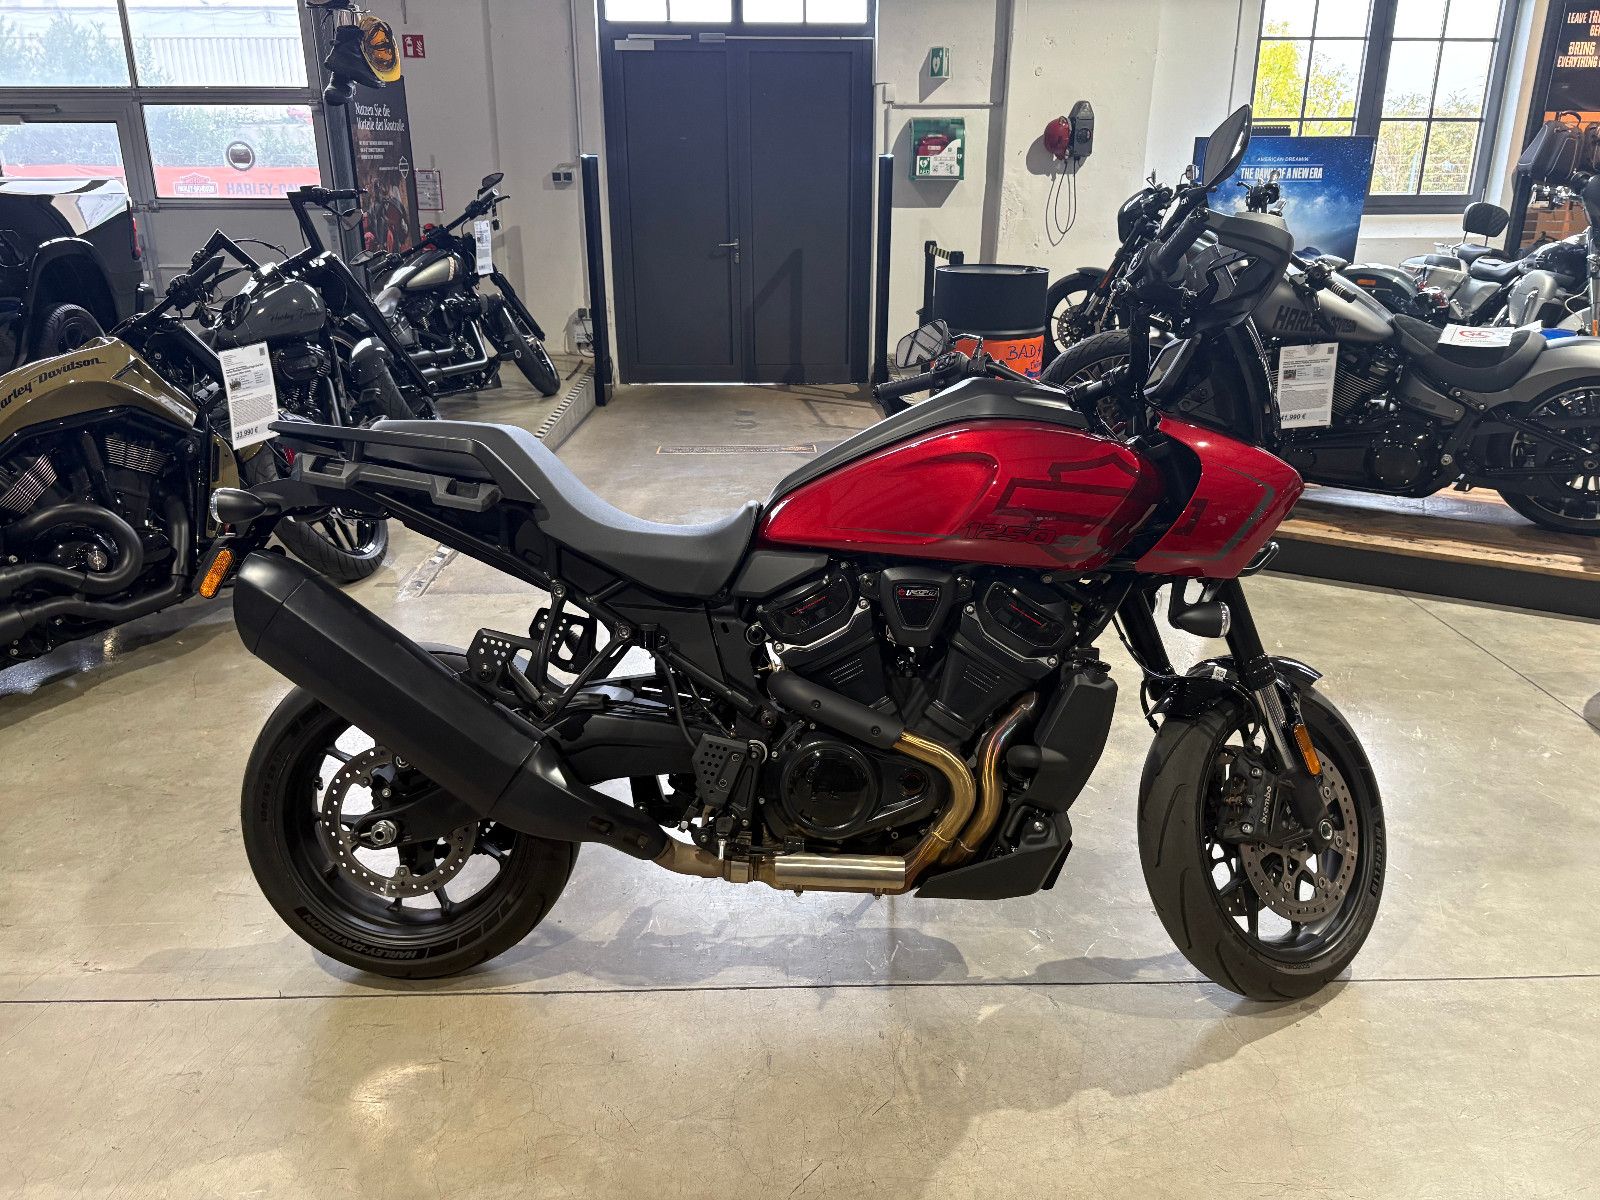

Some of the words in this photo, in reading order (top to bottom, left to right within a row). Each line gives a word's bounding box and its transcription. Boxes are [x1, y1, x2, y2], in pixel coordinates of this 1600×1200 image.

[1567, 12, 1588, 23] LEAVE
[1568, 42, 1596, 55] BRING
[1557, 56, 1598, 67] EVERYTHING
[374, 103, 382, 117] Sie
[1240, 168, 1255, 180] THE
[1255, 168, 1275, 180] DAW
[1287, 168, 1292, 180] A
[1292, 168, 1309, 180] NEW
[1309, 168, 1323, 180] ERA
[0, 357, 106, 412] arley-Davidson
[1259, 785, 1272, 825] brembo
[1370, 823, 1384, 894] MICHELIN
[302, 912, 418, 960] HARLEY-DAVIDSON
